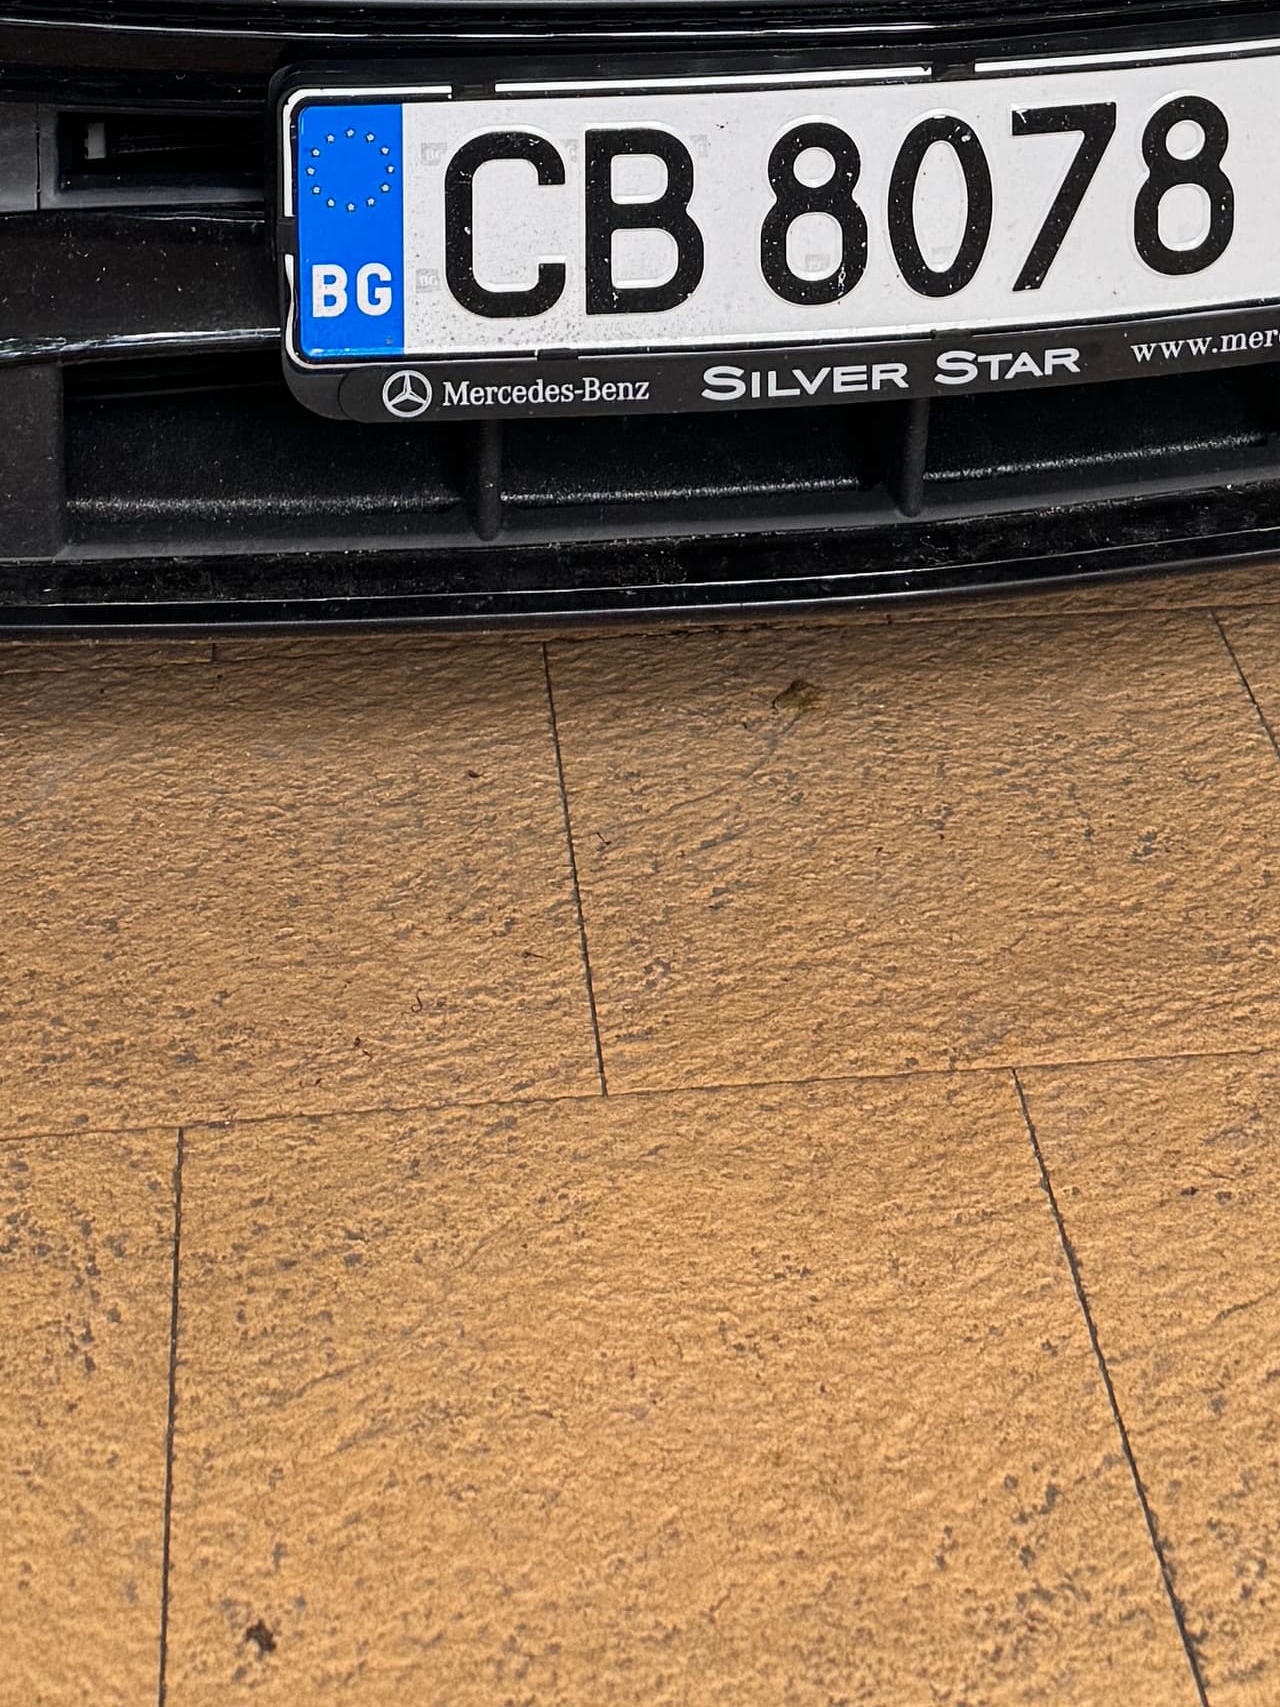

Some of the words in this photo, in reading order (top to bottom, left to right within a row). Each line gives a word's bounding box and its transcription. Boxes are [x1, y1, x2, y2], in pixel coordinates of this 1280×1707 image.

[445, 129, 704, 318] CB
[761, 96, 1234, 305] 8078
[312, 263, 392, 318] BG
[442, 377, 650, 407] Mercedes-Benz
[701, 362, 909, 401] SILVER
[934, 347, 1081, 385] STAR
